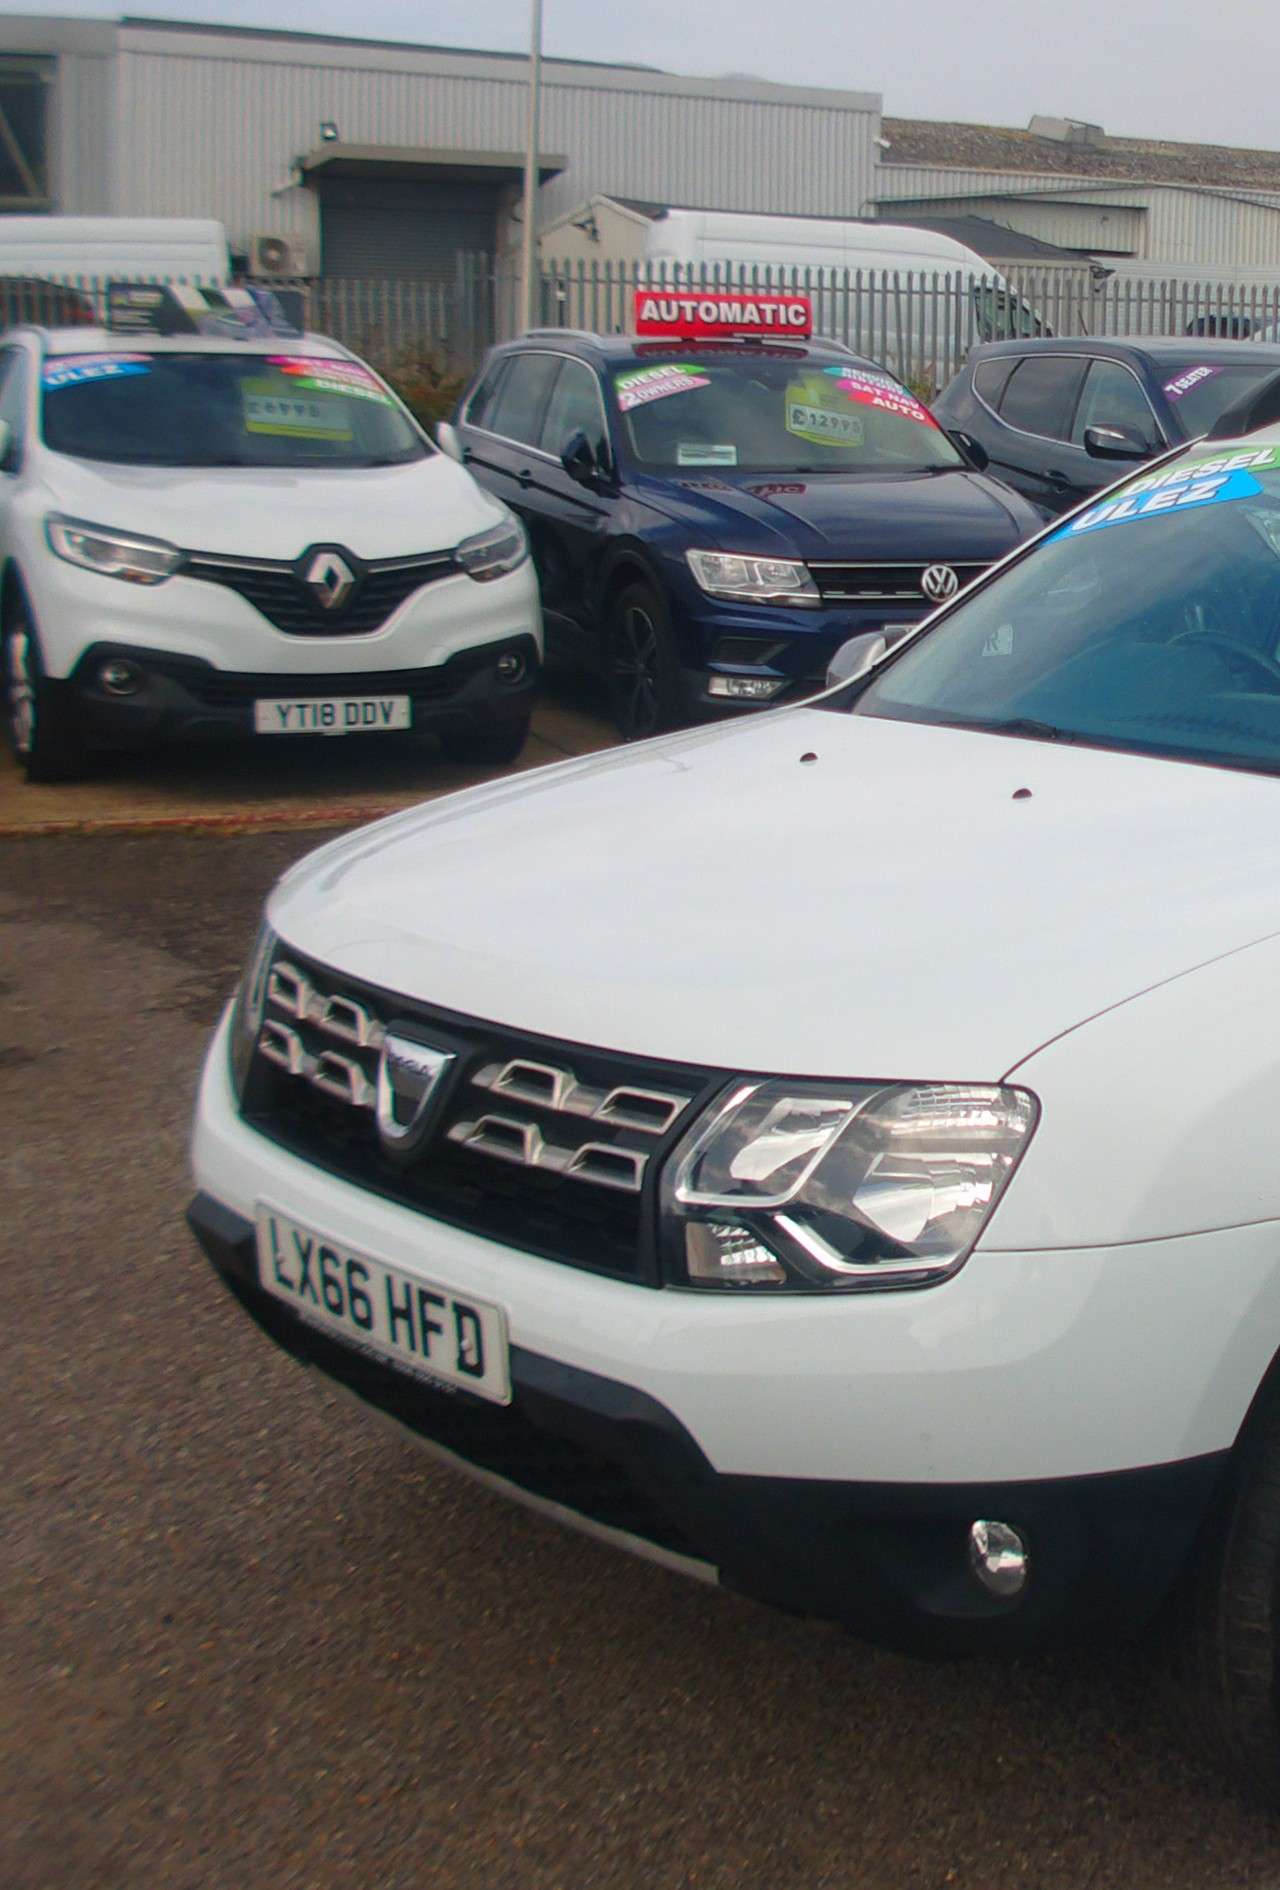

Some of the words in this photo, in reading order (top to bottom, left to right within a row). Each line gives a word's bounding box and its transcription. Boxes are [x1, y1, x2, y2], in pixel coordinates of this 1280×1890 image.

[640, 299, 807, 326] AUTOMATIC
[621, 364, 686, 391] DIESEL
[624, 391, 642, 407] 2
[637, 376, 694, 403] OWNERS
[1164, 384, 1183, 395] 7
[1174, 366, 1213, 389] SEATER
[851, 381, 882, 399] SAT
[887, 393, 920, 410] NAV
[872, 397, 926, 421] AUTO
[1119, 447, 1278, 497] DIESEL
[1071, 476, 1231, 531] ULEZ
[275, 703, 335, 728] YT18
[344, 701, 394, 726] DDV
[269, 1216, 374, 1331] LX66
[385, 1273, 485, 1379] HFD
